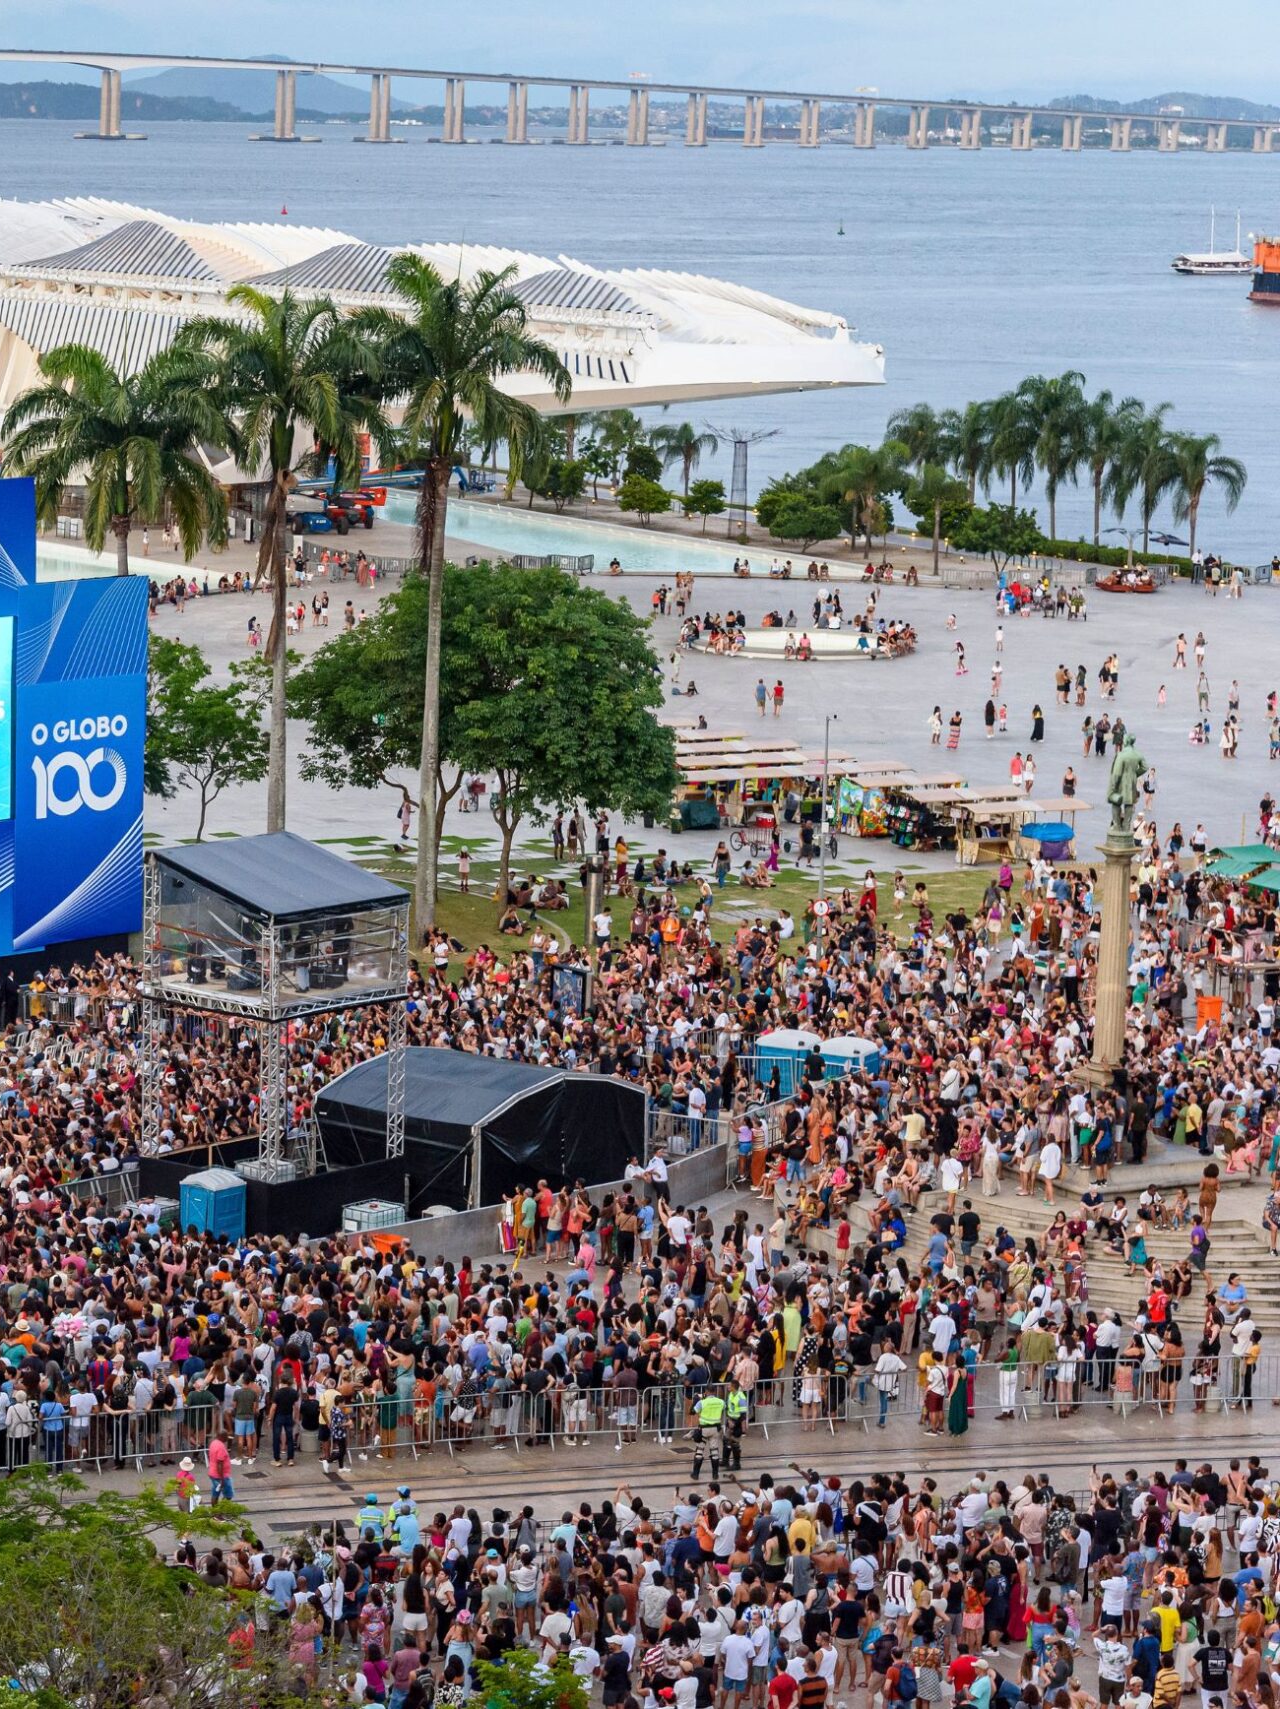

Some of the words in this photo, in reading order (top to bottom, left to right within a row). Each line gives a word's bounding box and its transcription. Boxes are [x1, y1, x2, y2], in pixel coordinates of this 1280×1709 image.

[31, 723, 49, 746] O
[52, 714, 128, 743] GLOBO
[31, 747, 127, 819] 100
